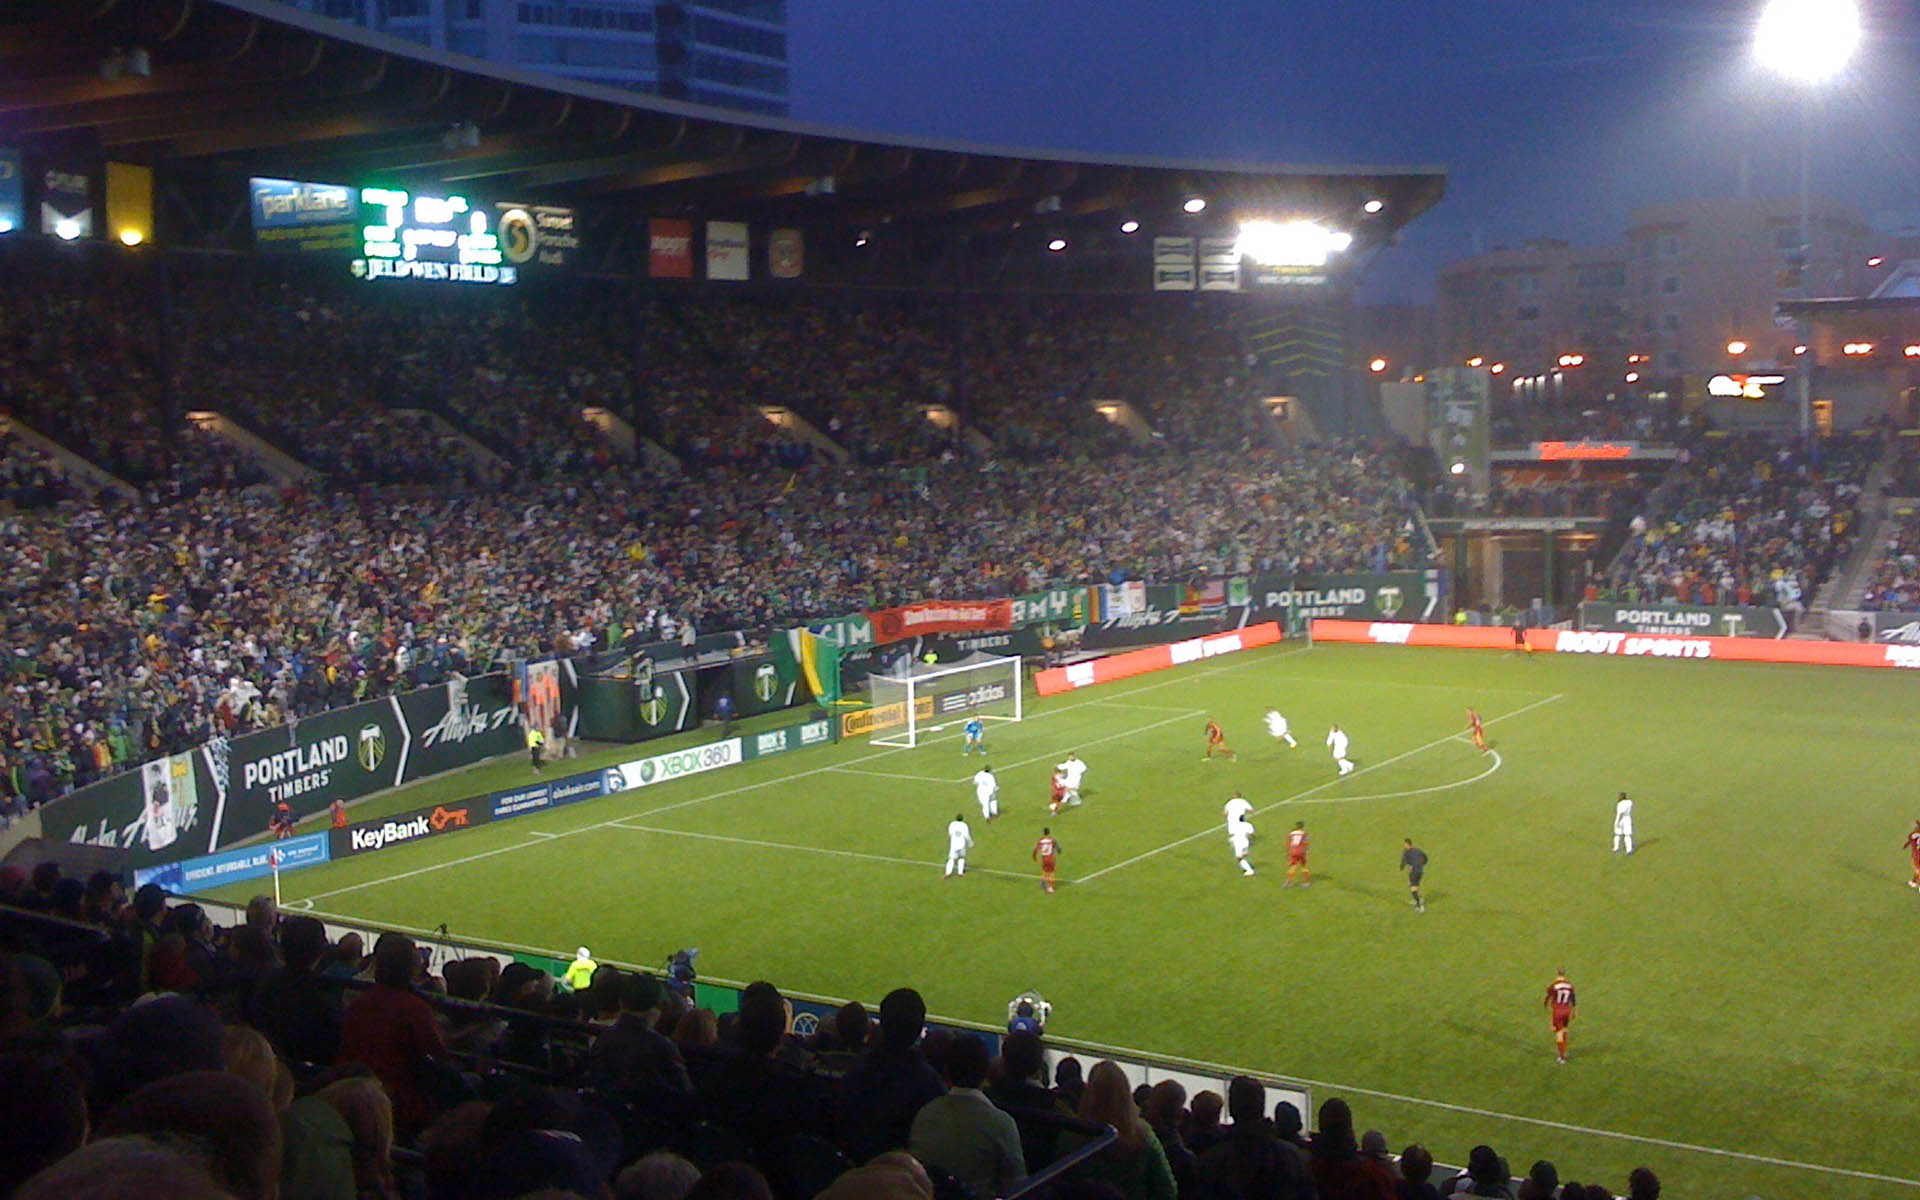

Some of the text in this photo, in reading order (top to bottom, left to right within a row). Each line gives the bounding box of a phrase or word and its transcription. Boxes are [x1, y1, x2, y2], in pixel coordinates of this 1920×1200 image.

[1615, 609, 1711, 627] PORTLAND
[1624, 637, 1711, 659] SPORTS
[968, 685, 1005, 706] adidas
[244, 735, 348, 789] PORTLAND
[660, 744, 731, 777] XBOX 360
[268, 769, 329, 802] TIMBERS
[351, 815, 430, 850] KeyBank
[1557, 989, 1571, 1004] 17
